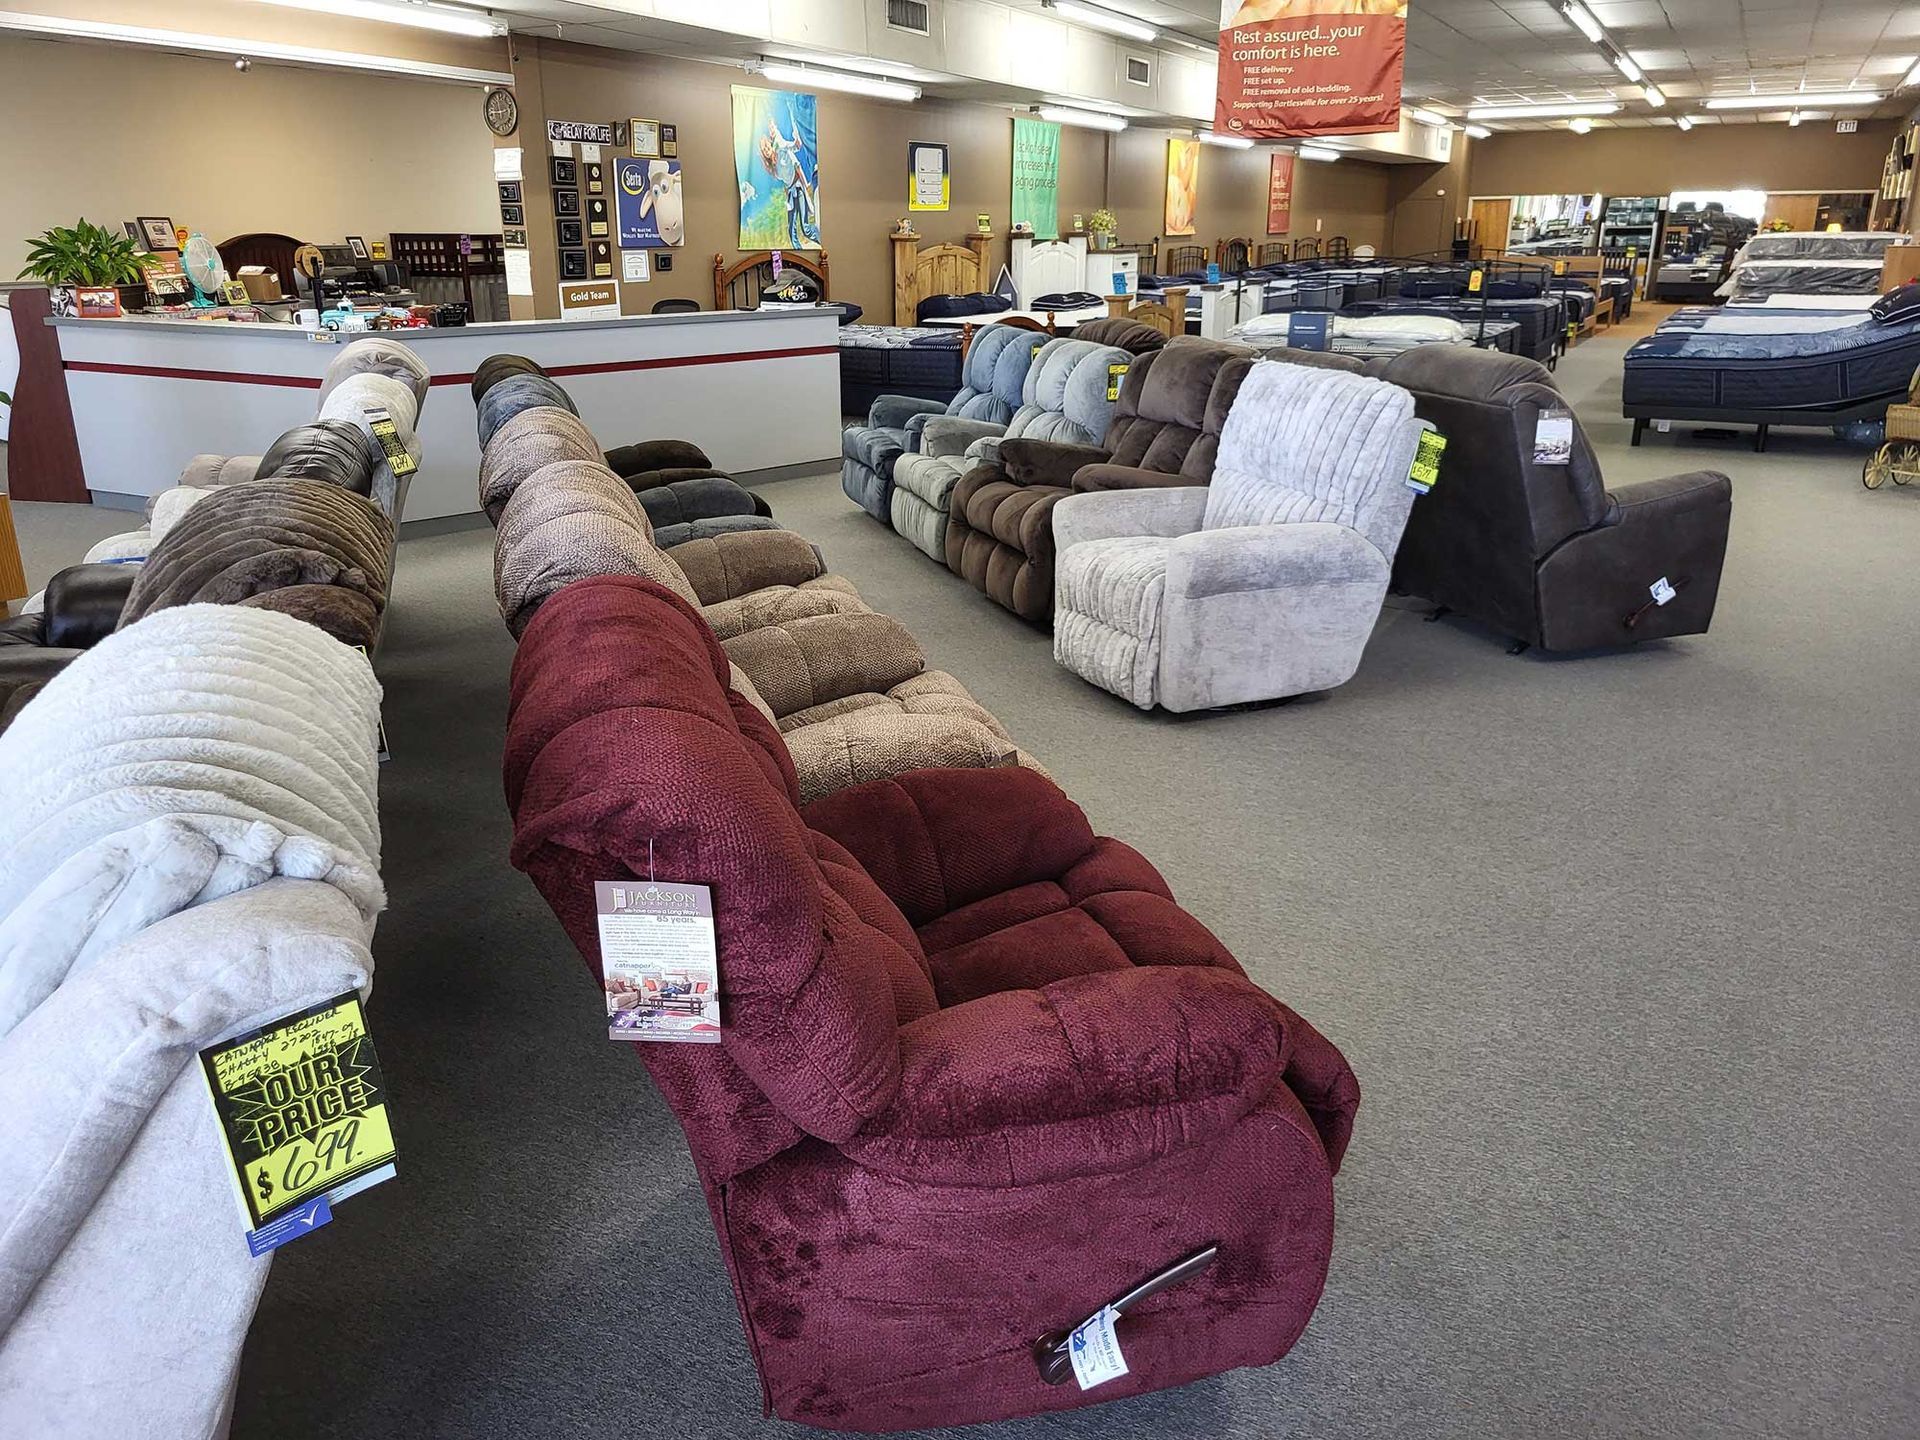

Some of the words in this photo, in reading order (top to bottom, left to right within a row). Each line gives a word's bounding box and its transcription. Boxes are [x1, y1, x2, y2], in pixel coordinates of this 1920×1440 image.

[1233, 31, 1261, 44] Rest
[1263, 25, 1365, 42] assured...your
[1232, 45, 1288, 61] comfort
[1289, 45, 1301, 58] is
[1303, 43, 1341, 57] here.
[1243, 66, 1261, 74] FREE
[1261, 65, 1295, 75] delivery.
[1242, 88, 1260, 96] FREE
[1260, 87, 1291, 95] removal
[1291, 86, 1302, 94] of
[1301, 85, 1316, 93] old
[1316, 84, 1352, 93] bedding.
[1243, 77, 1260, 85] FREE
[1260, 77, 1272, 85] set
[1272, 78, 1286, 86] up.
[1232, 101, 1274, 110] Supporting
[1273, 99, 1317, 108] Bartlesville
[1317, 98, 1330, 106] for
[1346, 95, 1359, 104] 25
[1358, 93, 1385, 104] years!
[562, 123, 583, 140] RELAY
[583, 126, 598, 141] FOR
[597, 127, 610, 142] LIFE
[625, 170, 642, 187] Serta
[570, 292, 589, 302] Gold
[589, 290, 610, 301] Team
[629, 891, 696, 906] JACKSON
[265, 1053, 344, 1109] OUR
[256, 1076, 369, 1152] PRICE
